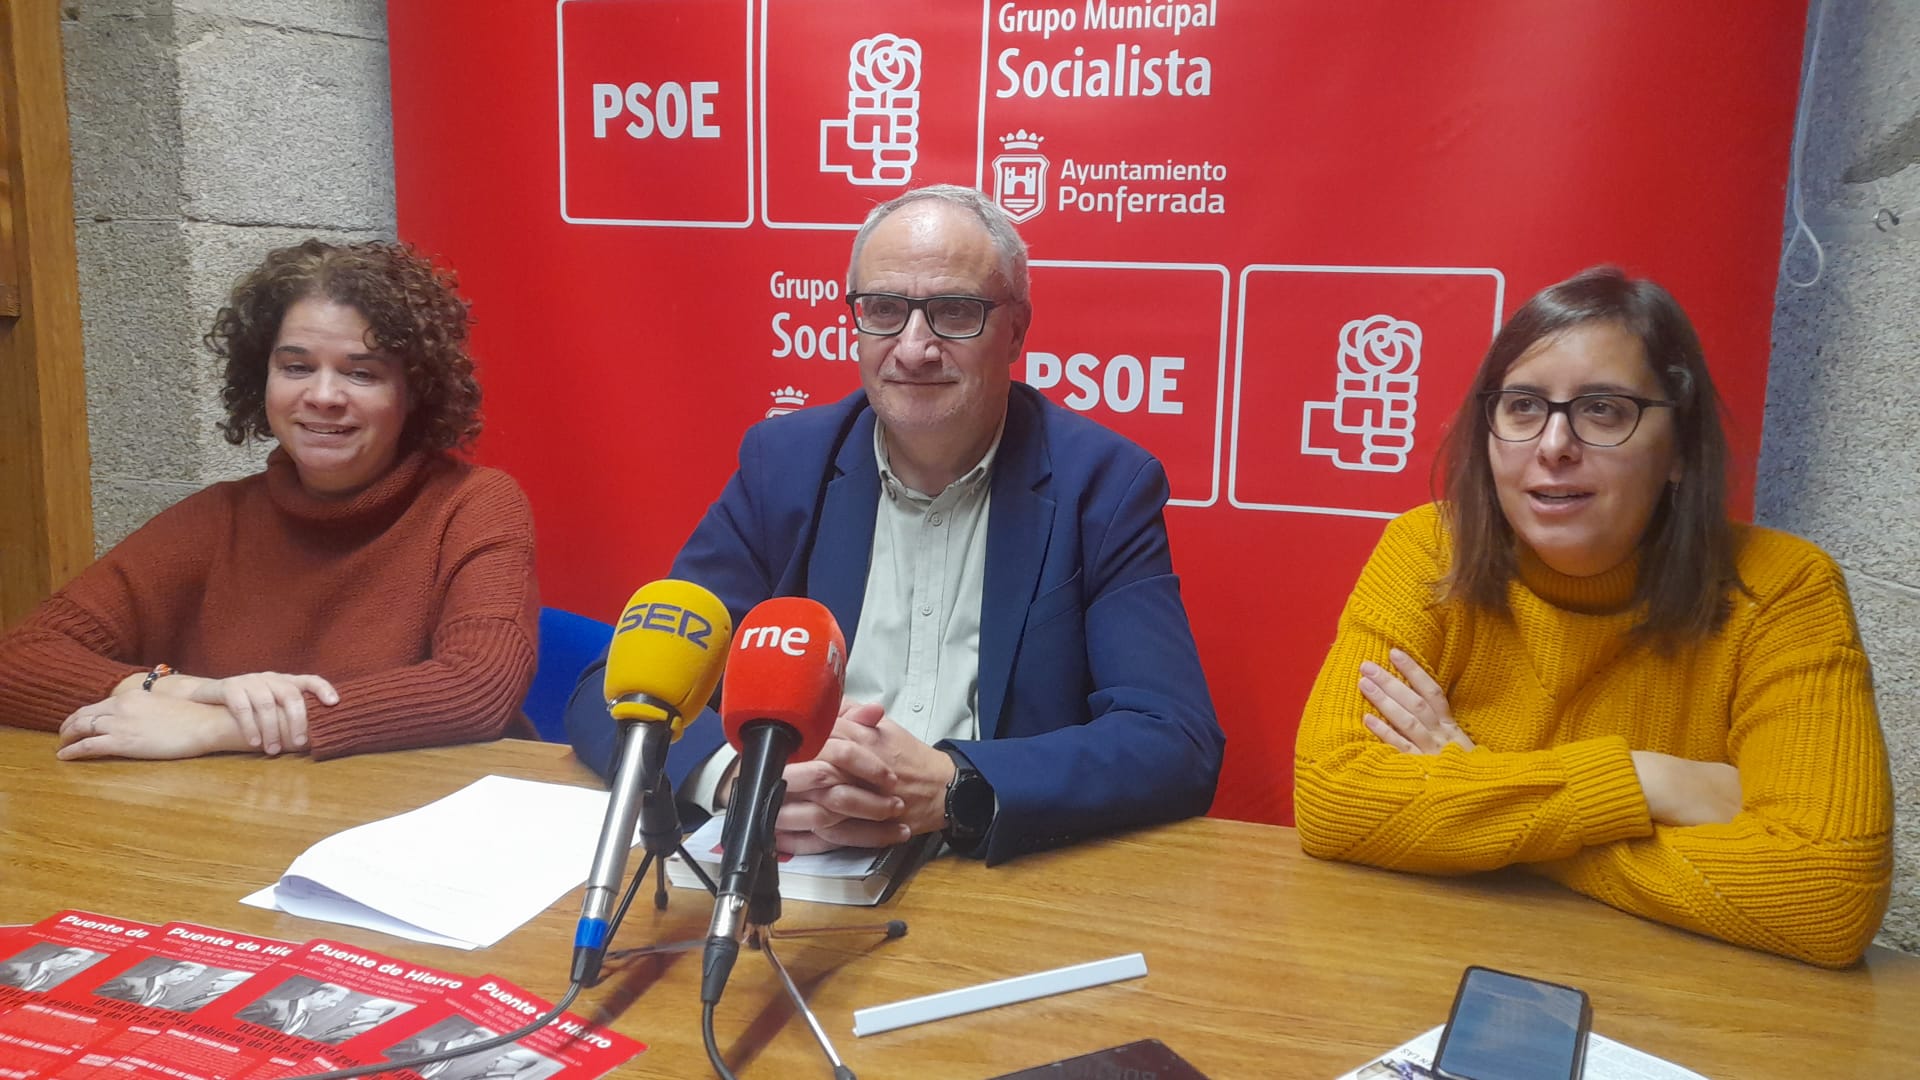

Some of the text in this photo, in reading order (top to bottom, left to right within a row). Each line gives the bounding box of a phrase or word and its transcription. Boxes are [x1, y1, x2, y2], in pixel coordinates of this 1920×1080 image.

[998, 0, 1216, 39] Grupo Municipal
[996, 43, 1211, 98] Socialista
[592, 81, 720, 138] PSOE
[1060, 157, 1226, 185] Ayuntamiento
[1058, 185, 1225, 222] Ponferrada
[770, 270, 838, 307] Grupo
[1025, 351, 1185, 414] PSOE
[617, 602, 713, 650] SER
[740, 625, 809, 656] rne
[60, 915, 124, 934] Puente
[125, 928, 150, 938] de
[167, 927, 234, 947] Puente
[235, 941, 260, 952] de
[310, 943, 377, 968] Puente
[377, 963, 404, 976] de
[404, 969, 463, 989] Hierro
[479, 982, 537, 1015] Puente
[187, 1022, 246, 1044] gobierno
